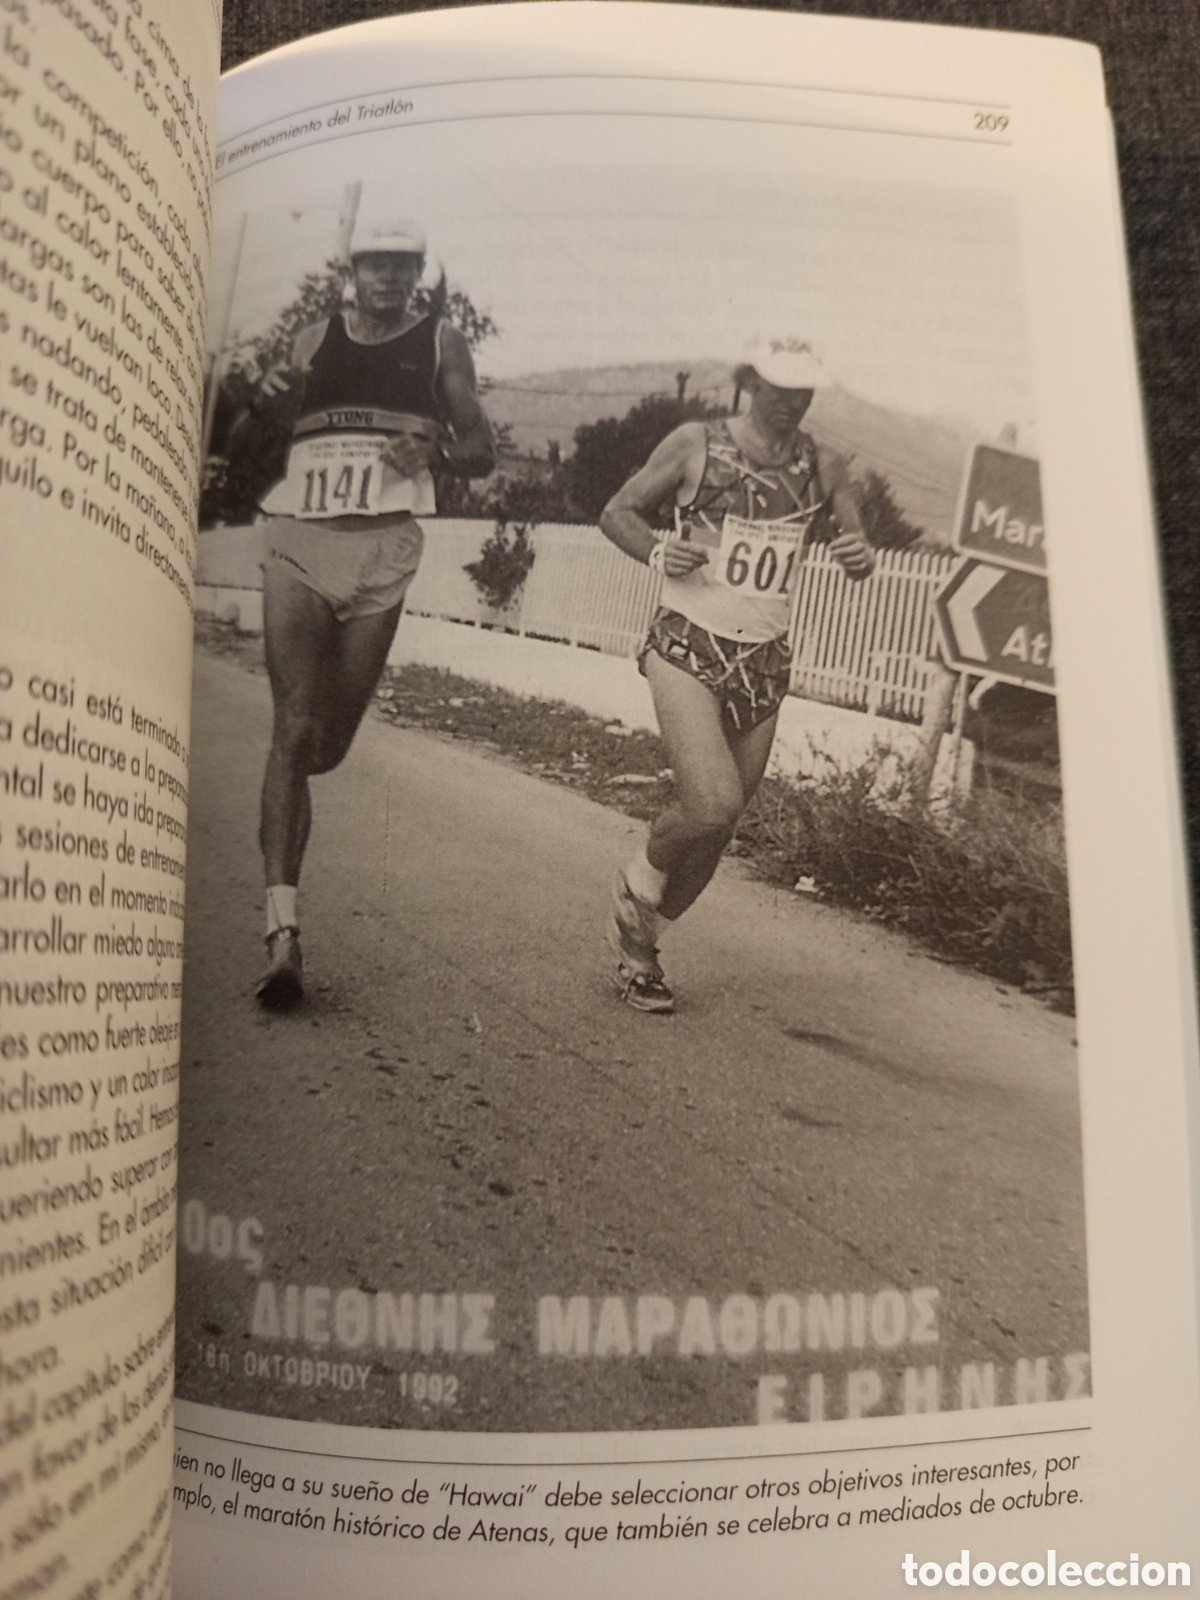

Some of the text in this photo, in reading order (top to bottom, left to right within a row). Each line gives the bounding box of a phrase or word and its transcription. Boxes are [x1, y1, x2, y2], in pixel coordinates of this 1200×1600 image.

[55, 0, 128, 81] asado.
[134, 70, 159, 118] Por
[163, 117, 185, 168] ello,
[125, 15, 160, 88] fase,
[165, 84, 191, 139] cada
[148, 20, 179, 78] cima
[183, 75, 194, 110] de
[214, 98, 415, 170] El entrenamiento del Triatlón
[973, 113, 1010, 133] 209
[33, 103, 65, 143] un
[75, 137, 131, 203] plano
[42, 69, 162, 208] competición,
[168, 203, 191, 253] cada
[23, 184, 48, 218] al
[57, 211, 111, 265] calor
[32, 149, 111, 224] cuerpo
[117, 219, 154, 272] para
[158, 266, 185, 318] saber
[47, 279, 68, 322] le
[74, 311, 143, 384] vuelvan
[82, 274, 116, 316] son
[121, 294, 143, 342] las
[146, 327, 163, 364] de
[22, 324, 126, 415] nadando,
[10, 364, 38, 396] se
[46, 380, 98, 432] trata
[104, 415, 126, 453] de
[60, 487, 75, 510] e
[81, 487, 131, 545] invita
[63, 431, 98, 477] Por
[104, 453, 121, 493] la
[126, 482, 178, 550] mañana,
[300, 465, 374, 513] 1141
[969, 499, 1047, 550] Mar
[726, 541, 797, 595] 601
[22, 709, 126, 773] dedicarse
[131, 756, 140, 778] a
[144, 747, 155, 783] la
[28, 676, 75, 709] casi
[86, 693, 123, 726] está
[131, 705, 180, 759] terminado
[53, 781, 76, 808] se
[84, 772, 128, 826] haya
[133, 790, 154, 827] ida
[16, 819, 109, 863] sesiones
[116, 829, 136, 866] de
[55, 881, 82, 907] en
[89, 870, 106, 908] el
[111, 886, 167, 916] momento
[94, 921, 143, 959] miedo
[0, 974, 87, 1007] nuestro
[96, 971, 169, 1015] preparativo
[38, 1030, 99, 1058] como
[105, 1012, 146, 1050] fuerte
[90, 1078, 103, 1112] y
[108, 1073, 128, 1098] un
[132, 1055, 160, 1093] calor
[69, 1118, 110, 1155] más
[115, 1102, 147, 1146] fácil.
[111, 1154, 159, 1197] superar
[99, 1210, 121, 1246] En
[125, 1196, 138, 1235] el
[50, 1257, 133, 1316] situación
[251, 1281, 496, 1353] ΔΙΕΘΝΗΣ
[537, 1288, 940, 1355] ΜΑΡΑΘΩΝΙΟΣ
[399, 1370, 459, 1405] 1992
[204, 1461, 225, 1479] no
[231, 1457, 276, 1493] llega
[282, 1476, 295, 1492] a
[302, 1478, 324, 1496] su
[331, 1479, 394, 1503] sueño
[401, 1479, 430, 1505] de
[545, 1481, 603, 1507] debe
[611, 1478, 739, 1506] seleccionar
[745, 1479, 800, 1500] otros
[808, 1468, 903, 1500] objetivos
[911, 1457, 1037, 1487] interesantes,
[1045, 1453, 1081, 1480] por
[223, 1492, 239, 1516] el
[244, 1506, 326, 1531] maratón
[333, 1507, 425, 1540] histórico
[432, 1515, 461, 1541] de
[467, 1519, 556, 1547] Atenas,
[565, 1525, 608, 1549] que
[616, 1513, 708, 1541] también
[716, 1519, 740, 1536] se
[747, 1505, 829, 1533] celebra
[836, 1510, 851, 1528] a
[858, 1492, 962, 1526] mediados
[969, 1488, 996, 1515] de
[1002, 1482, 1084, 1512] octubre.
